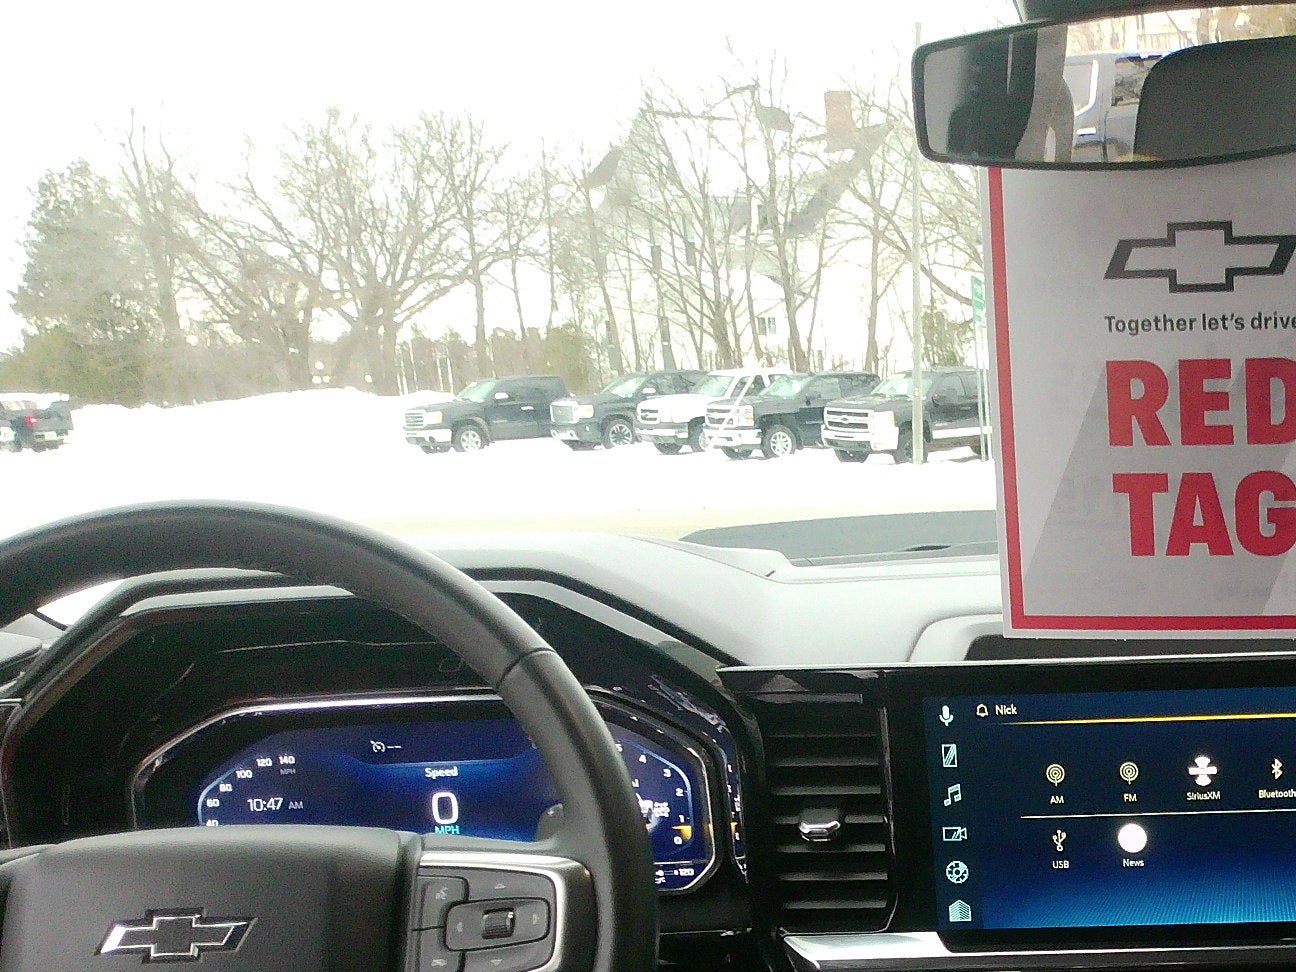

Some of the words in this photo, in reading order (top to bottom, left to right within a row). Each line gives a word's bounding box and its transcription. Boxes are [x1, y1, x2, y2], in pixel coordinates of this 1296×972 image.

[1104, 313, 1197, 336] Together
[1201, 312, 1246, 332] let's
[995, 703, 1018, 716] Nick
[255, 758, 273, 767] 120
[278, 755, 296, 765] 140
[235, 769, 253, 779] 100
[424, 765, 459, 780] Speed
[219, 783, 233, 793] 80
[1123, 793, 1138, 802] FM
[1186, 789, 1221, 801] SiriusXM
[1258, 788, 1296, 799] Bluetooth
[206, 798, 220, 808] 60
[247, 797, 284, 812] 10:47
[288, 800, 304, 810] AM
[1050, 795, 1065, 804] AM
[431, 791, 459, 825] 0
[434, 825, 460, 835] MPH
[1052, 860, 1070, 869] USB
[1122, 858, 1145, 868] News
